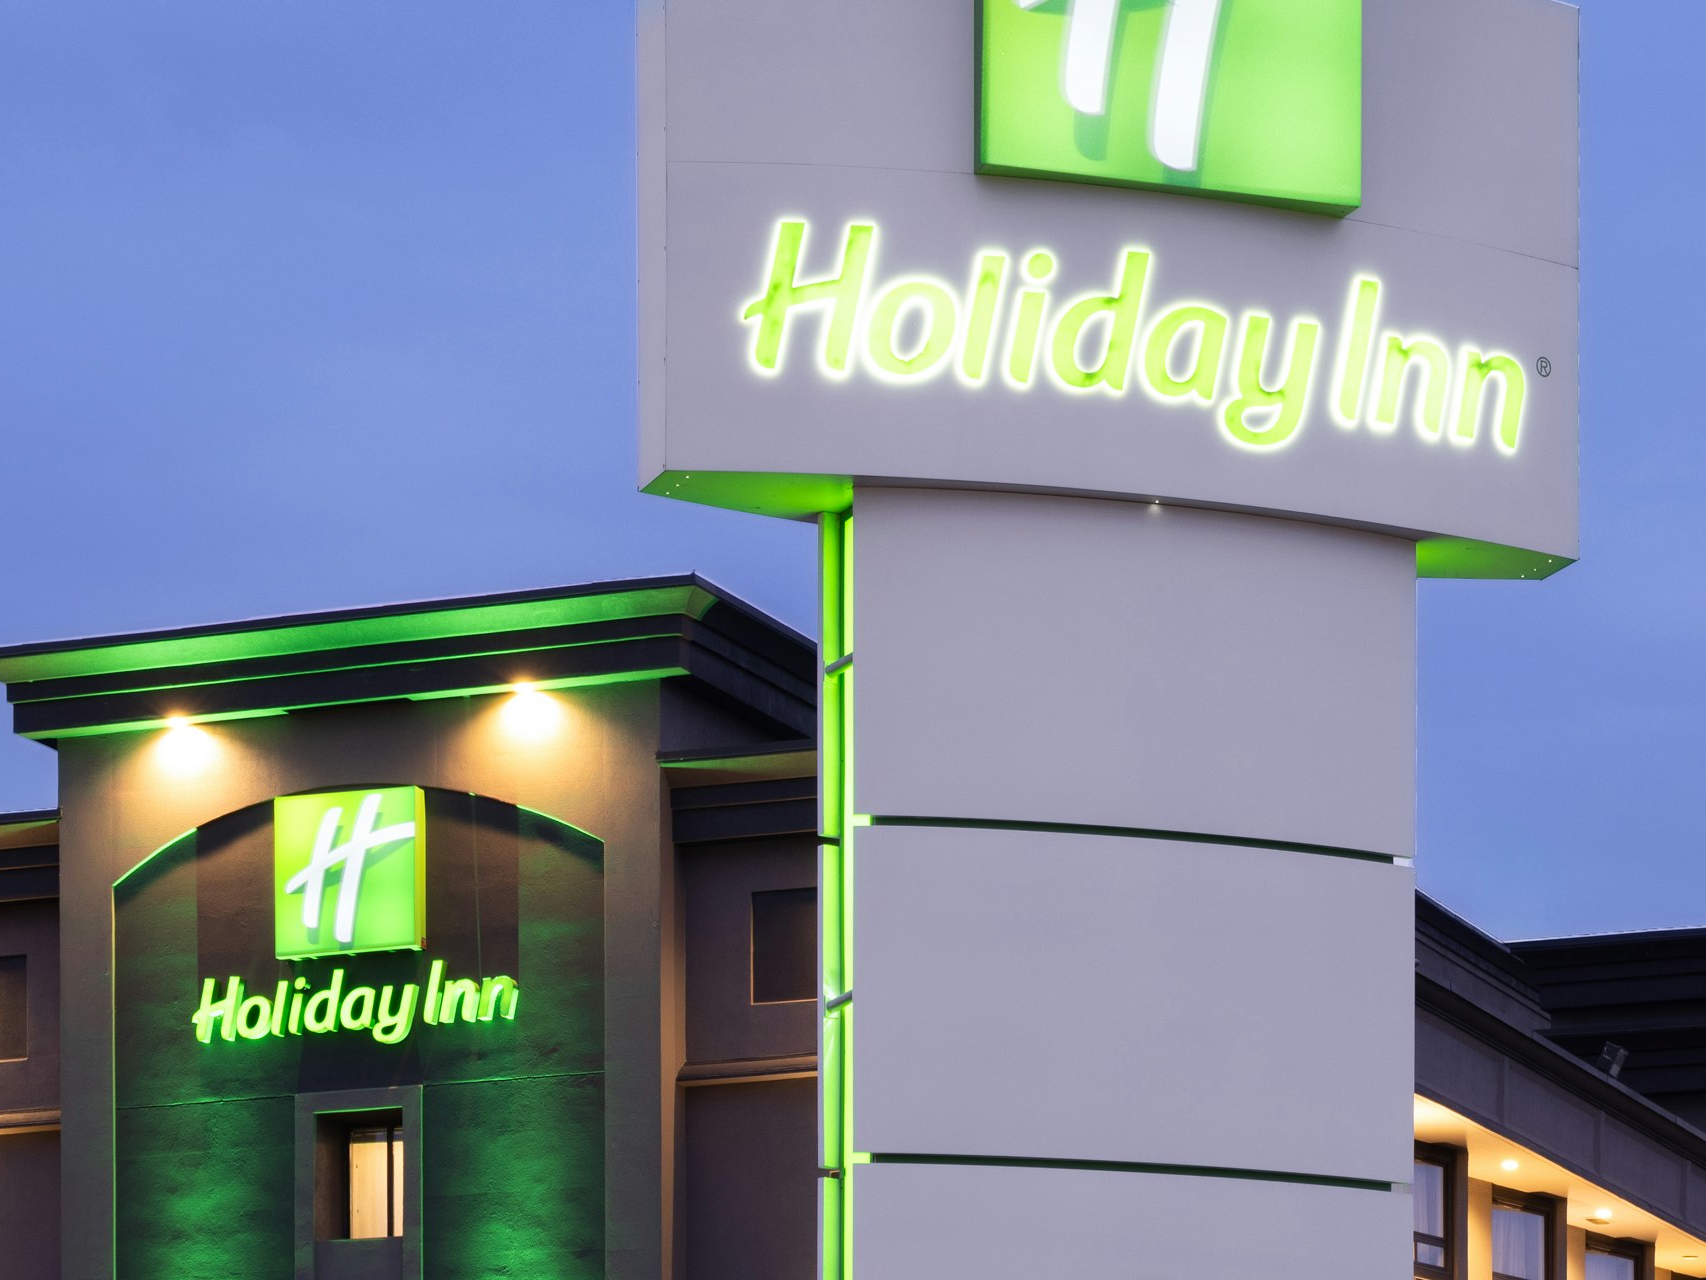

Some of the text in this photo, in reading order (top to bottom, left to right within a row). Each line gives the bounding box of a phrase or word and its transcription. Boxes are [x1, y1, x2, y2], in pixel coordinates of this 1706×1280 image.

[743, 218, 1321, 450] Holiday
[1333, 275, 1528, 454] Inn
[192, 959, 520, 1045] Holiday Inn
